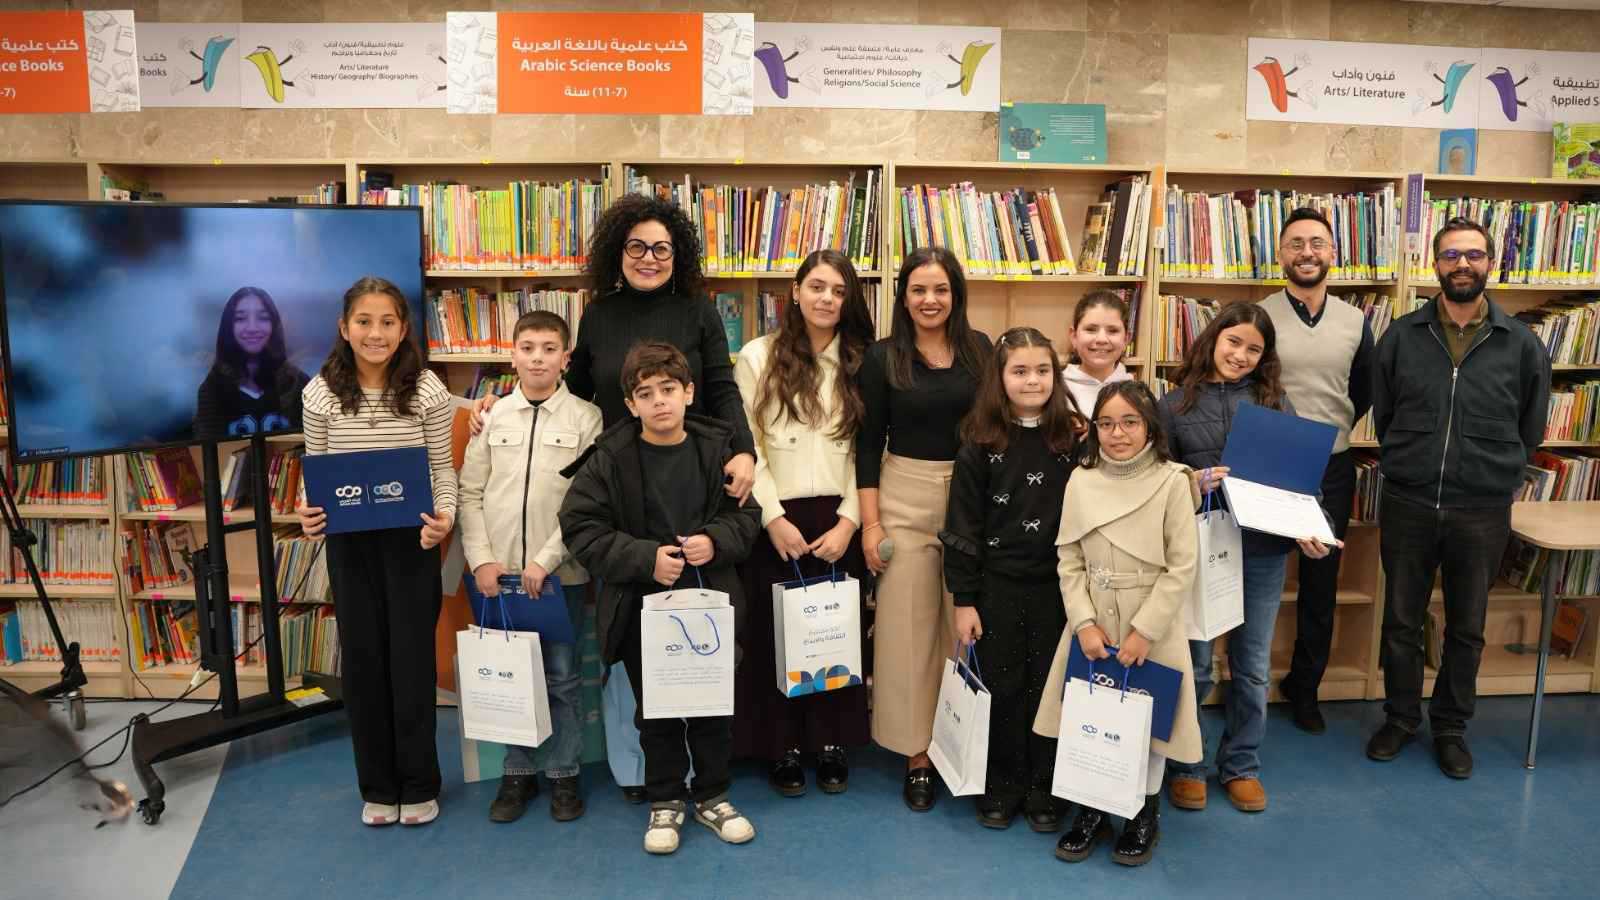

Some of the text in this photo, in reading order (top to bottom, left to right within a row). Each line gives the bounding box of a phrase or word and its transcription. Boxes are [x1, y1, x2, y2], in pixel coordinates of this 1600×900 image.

[2, 38, 80, 53] كتب علمية
[512, 38, 688, 53] كتب علمية باللغة العربية
[143, 53, 167, 62] كتب
[20, 59, 65, 72] Books
[339, 63, 389, 71] Arts/ Literature
[520, 59, 671, 72] Arabic Science Books
[140, 67, 167, 77] Books
[310, 72, 418, 81] History/ Geography/ Biographies
[823, 67, 922, 78] Generalities/ Philosophy
[1365, 70, 1396, 82] فنون
[890, 79, 921, 88] Science
[1553, 76, 1600, 91] تطبيقية
[564, 85, 590, 97] سنة
[1324, 85, 1406, 99] Arts/ Literature
[1551, 95, 1591, 108] Applied
